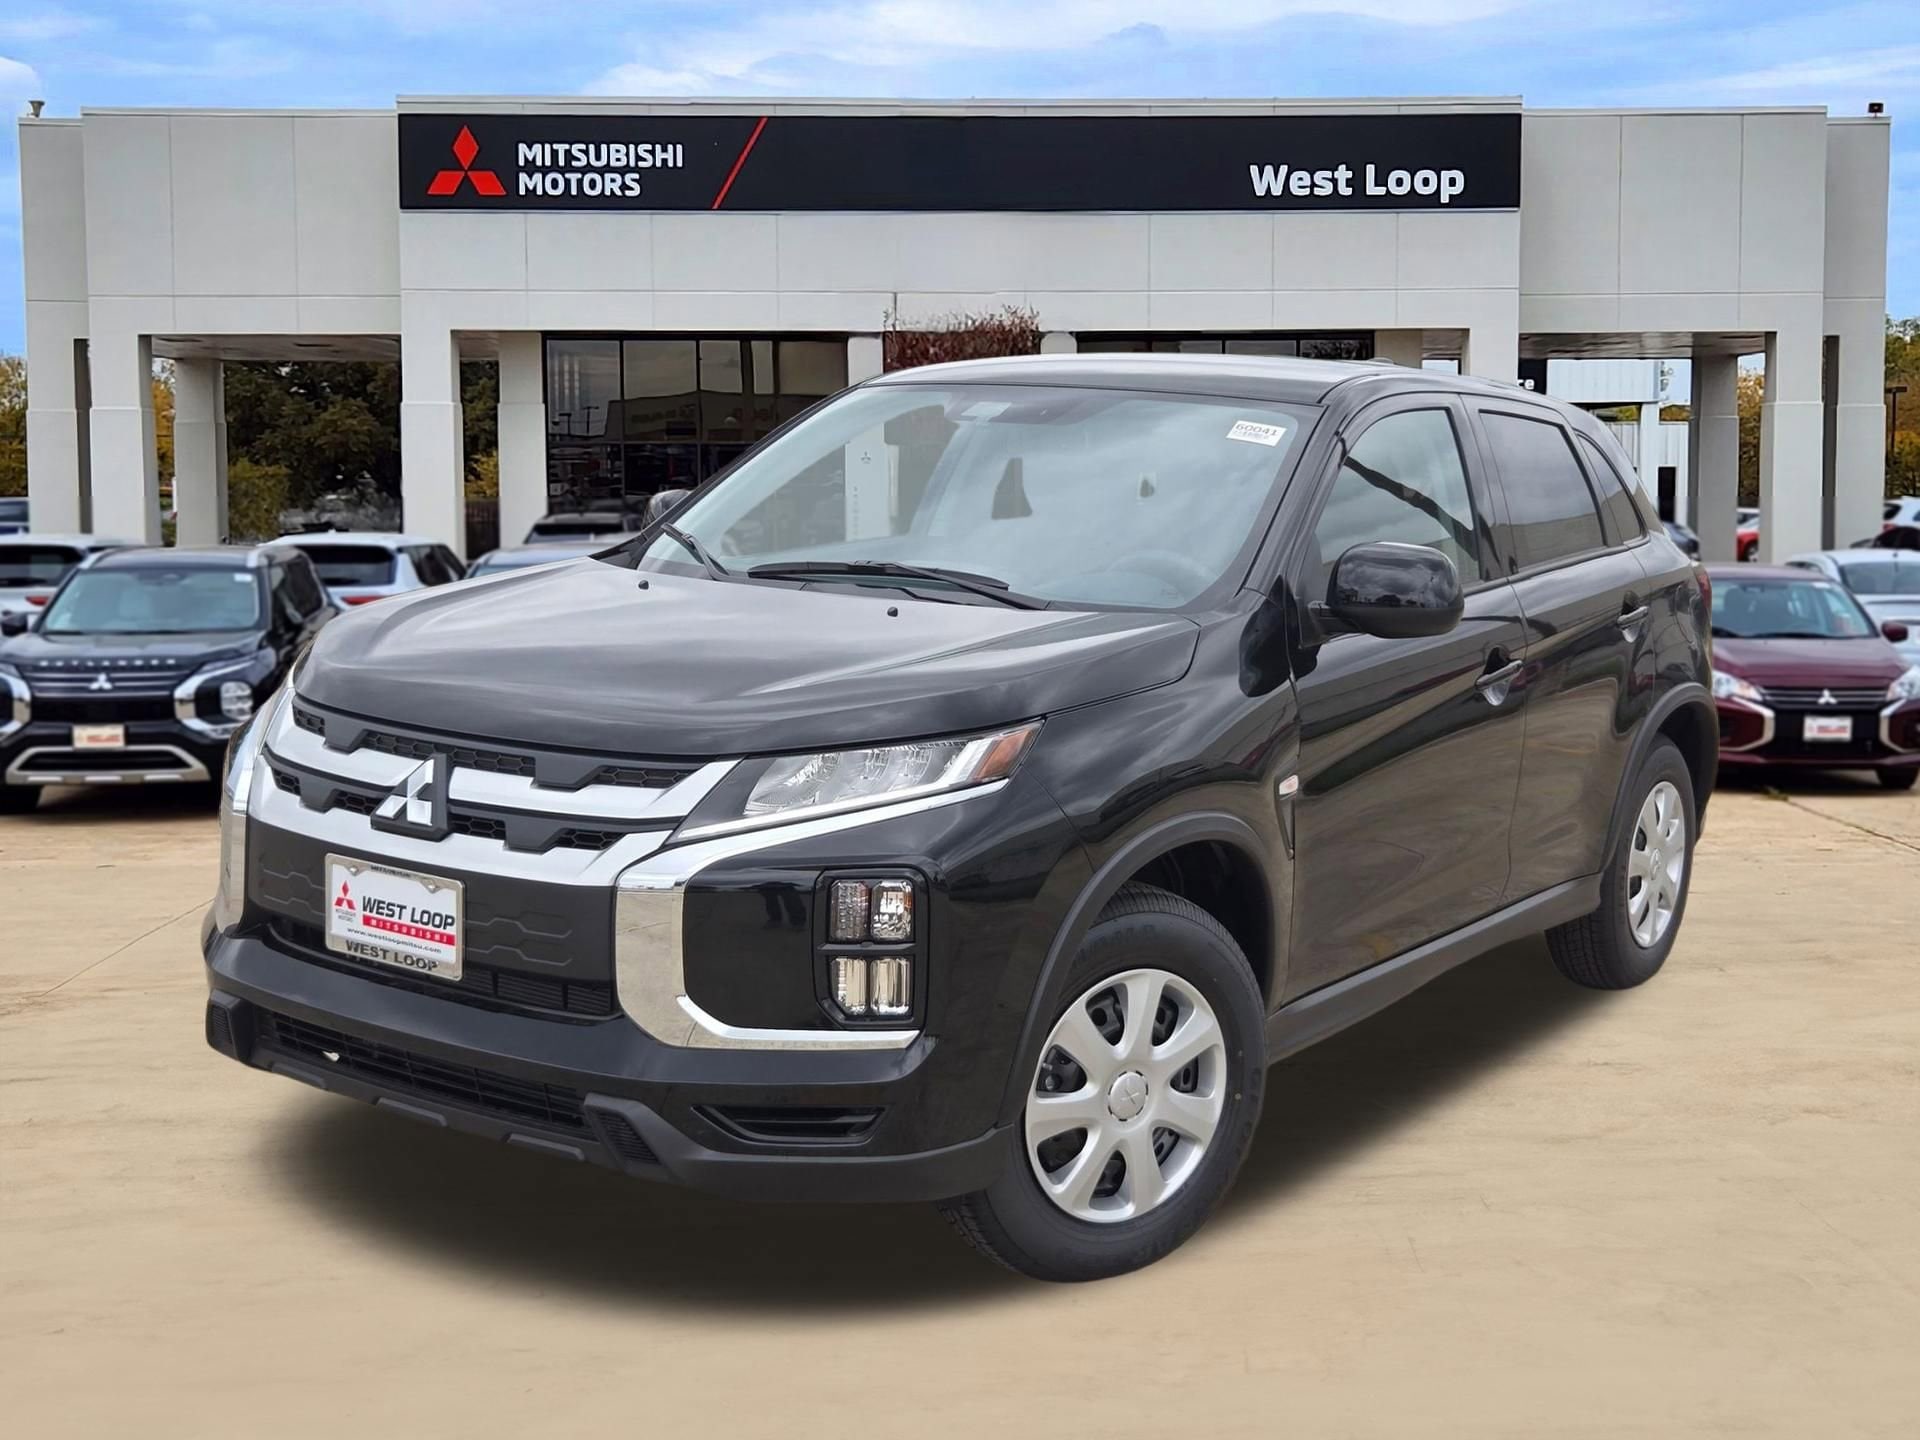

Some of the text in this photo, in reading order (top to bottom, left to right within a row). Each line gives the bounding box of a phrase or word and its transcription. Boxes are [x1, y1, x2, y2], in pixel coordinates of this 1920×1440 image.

[518, 143, 683, 168] MITSUBISHI
[518, 172, 641, 197] MOTORS
[1249, 164, 1465, 203] West Loop
[1235, 423, 1278, 436] 60041
[362, 895, 407, 920] WEST
[410, 907, 456, 930] LOOP
[370, 918, 447, 943] MITSUBISHI
[345, 940, 439, 971] WEST LOOP
